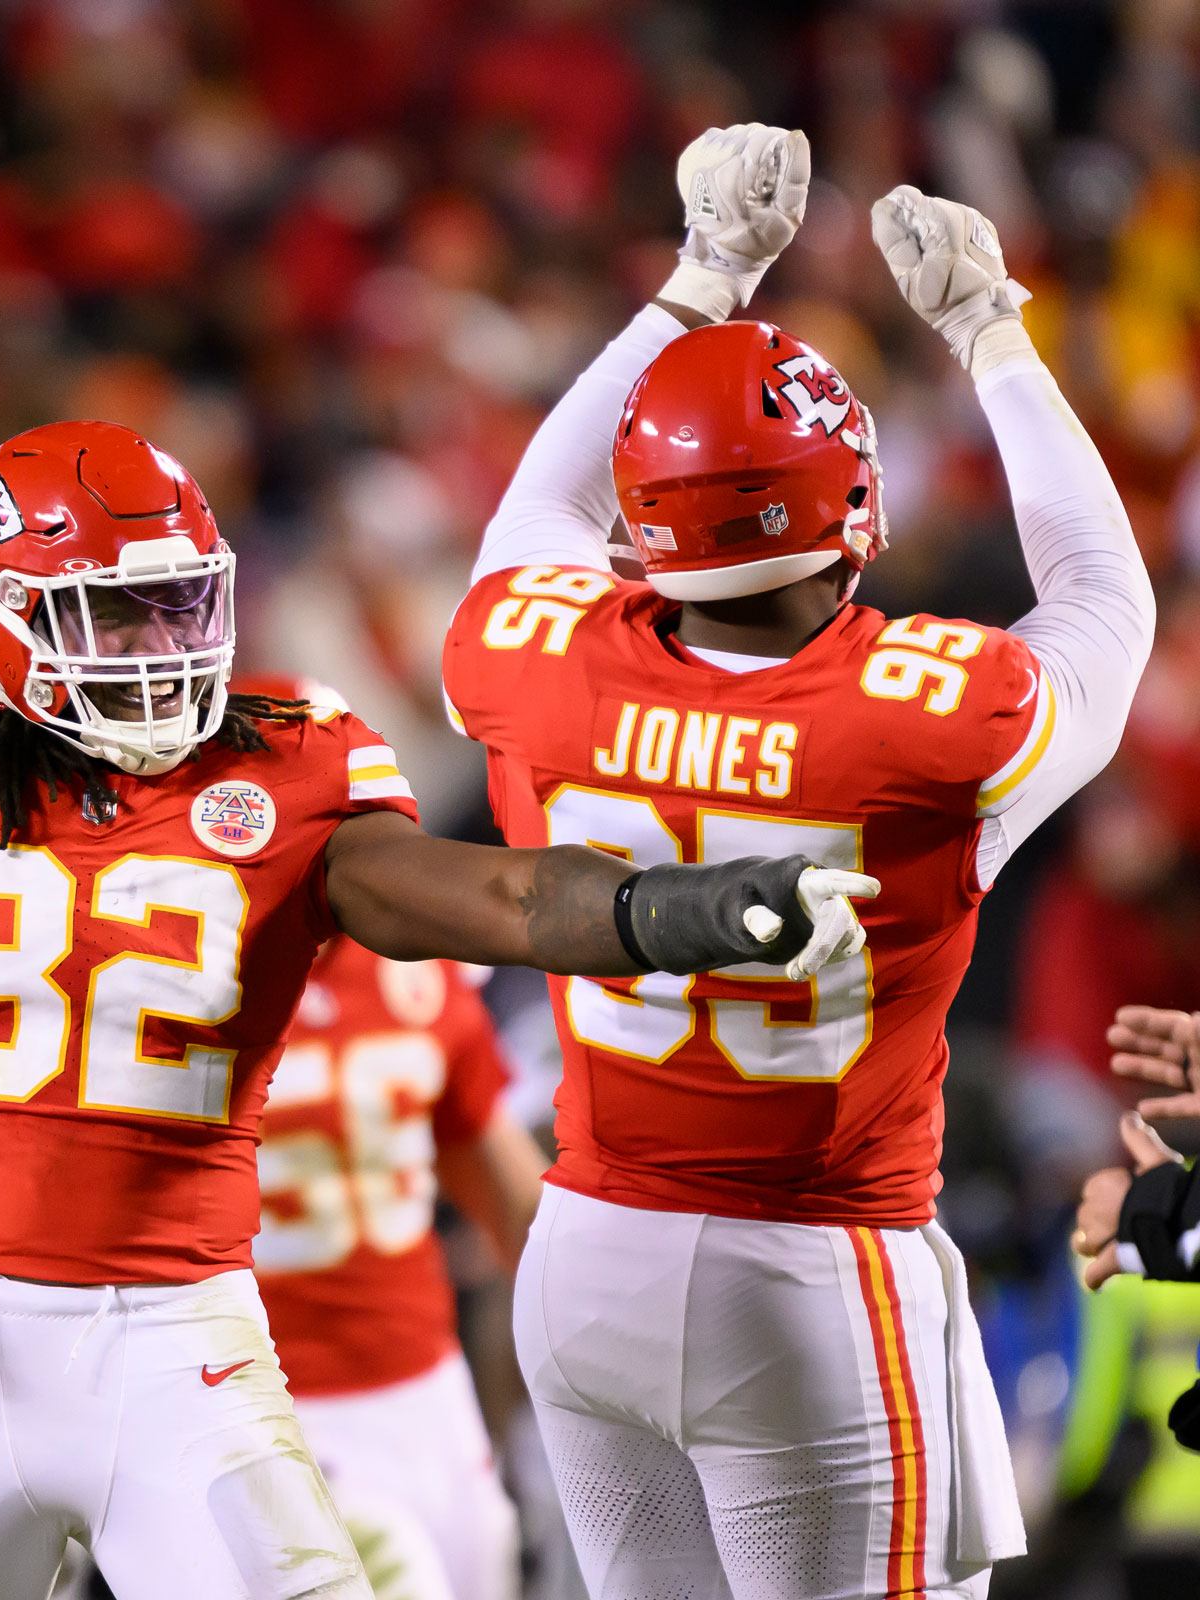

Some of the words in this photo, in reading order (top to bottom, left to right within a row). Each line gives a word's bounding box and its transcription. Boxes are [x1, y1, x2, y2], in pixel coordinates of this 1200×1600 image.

[793, 363, 849, 406] KC
[766, 514, 786, 532] NFL
[854, 534, 868, 551] 95
[481, 565, 617, 657] 95
[859, 614, 988, 718] 95
[593, 701, 800, 800] JONES
[201, 787, 265, 830] A
[222, 826, 243, 839] LH
